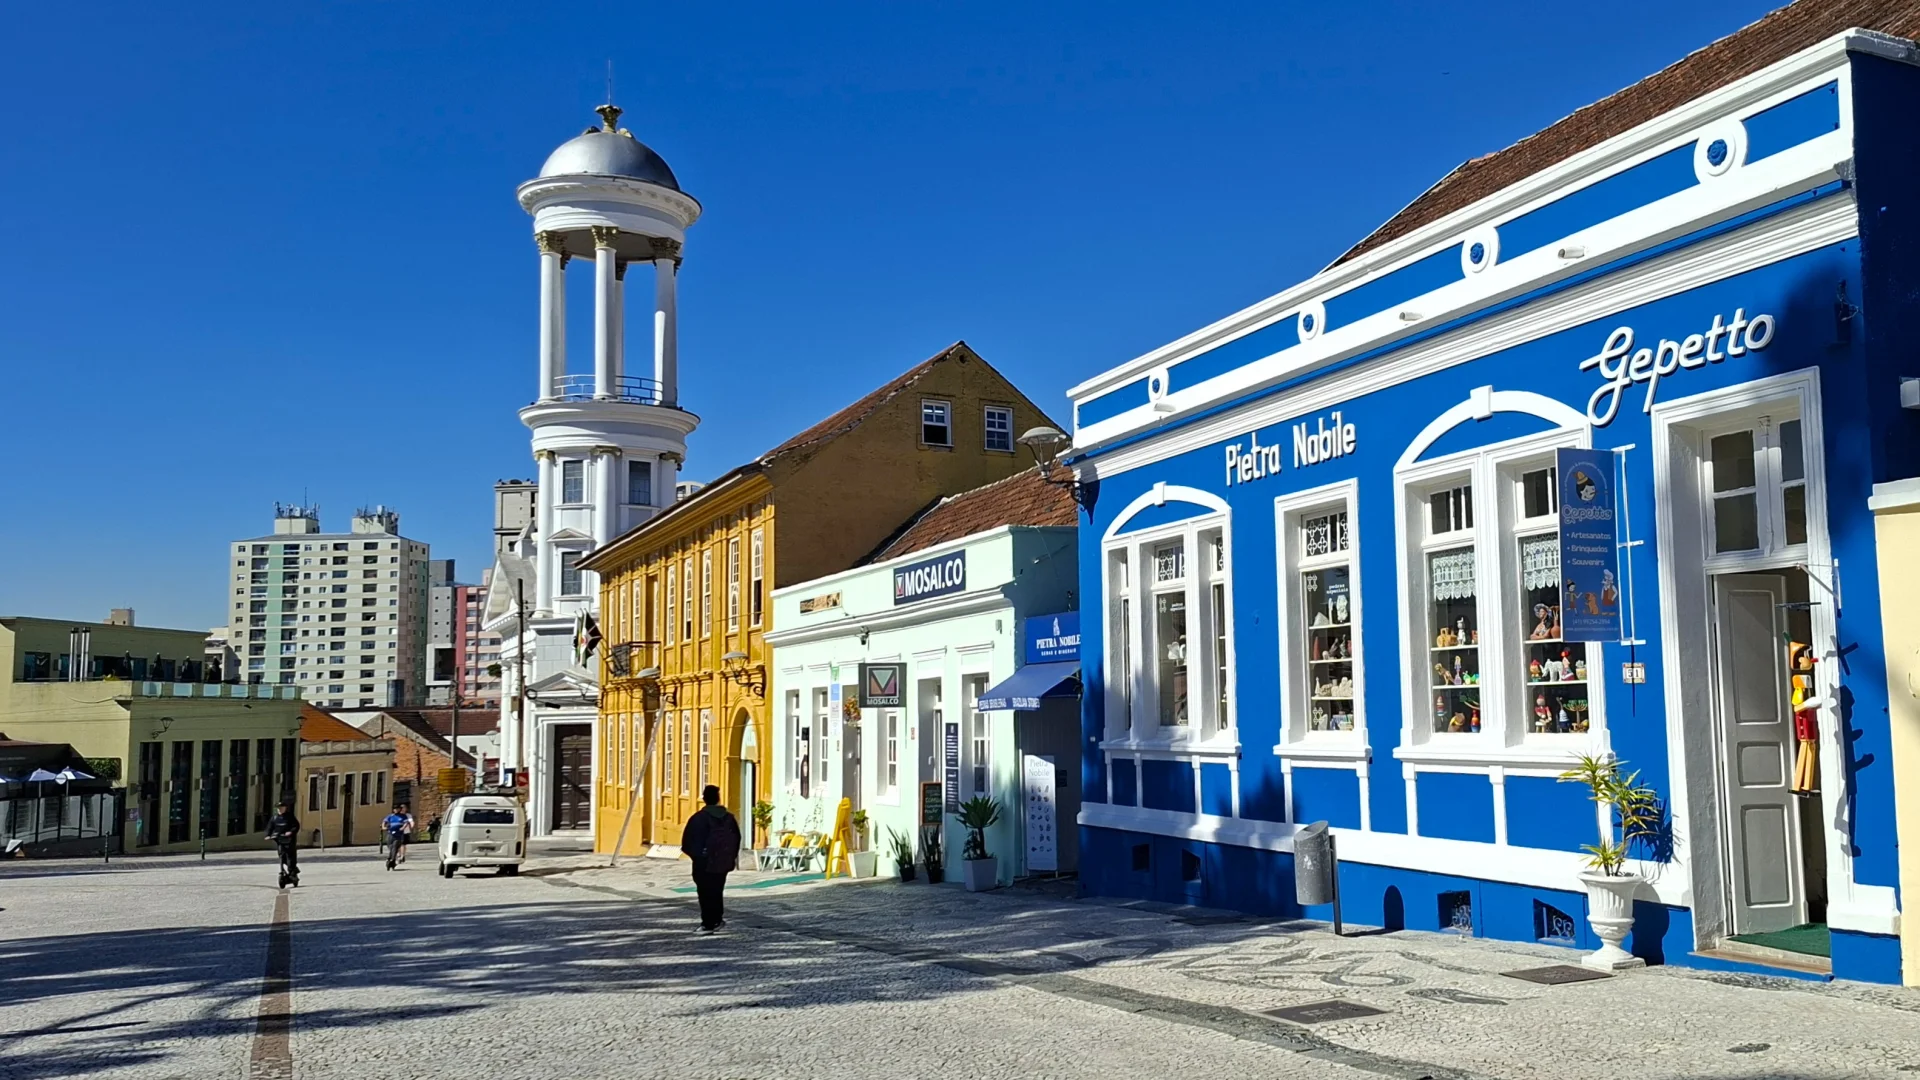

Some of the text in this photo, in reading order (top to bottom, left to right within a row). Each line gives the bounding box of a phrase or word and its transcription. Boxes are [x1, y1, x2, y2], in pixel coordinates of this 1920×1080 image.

[1578, 307, 1776, 427] Gepetto
[1225, 410, 1357, 487] Pietra Nobile
[1562, 504, 1613, 524] Gepetto
[1571, 531, 1611, 540] Artesanatos
[1571, 545, 1608, 554] Brinquedos
[1571, 558, 1605, 566] Souvenirs
[905, 558, 962, 596] MOSAI.CO
[1036, 634, 1081, 649] PIETRA NOBILE
[1028, 769, 1050, 777] Nobile
